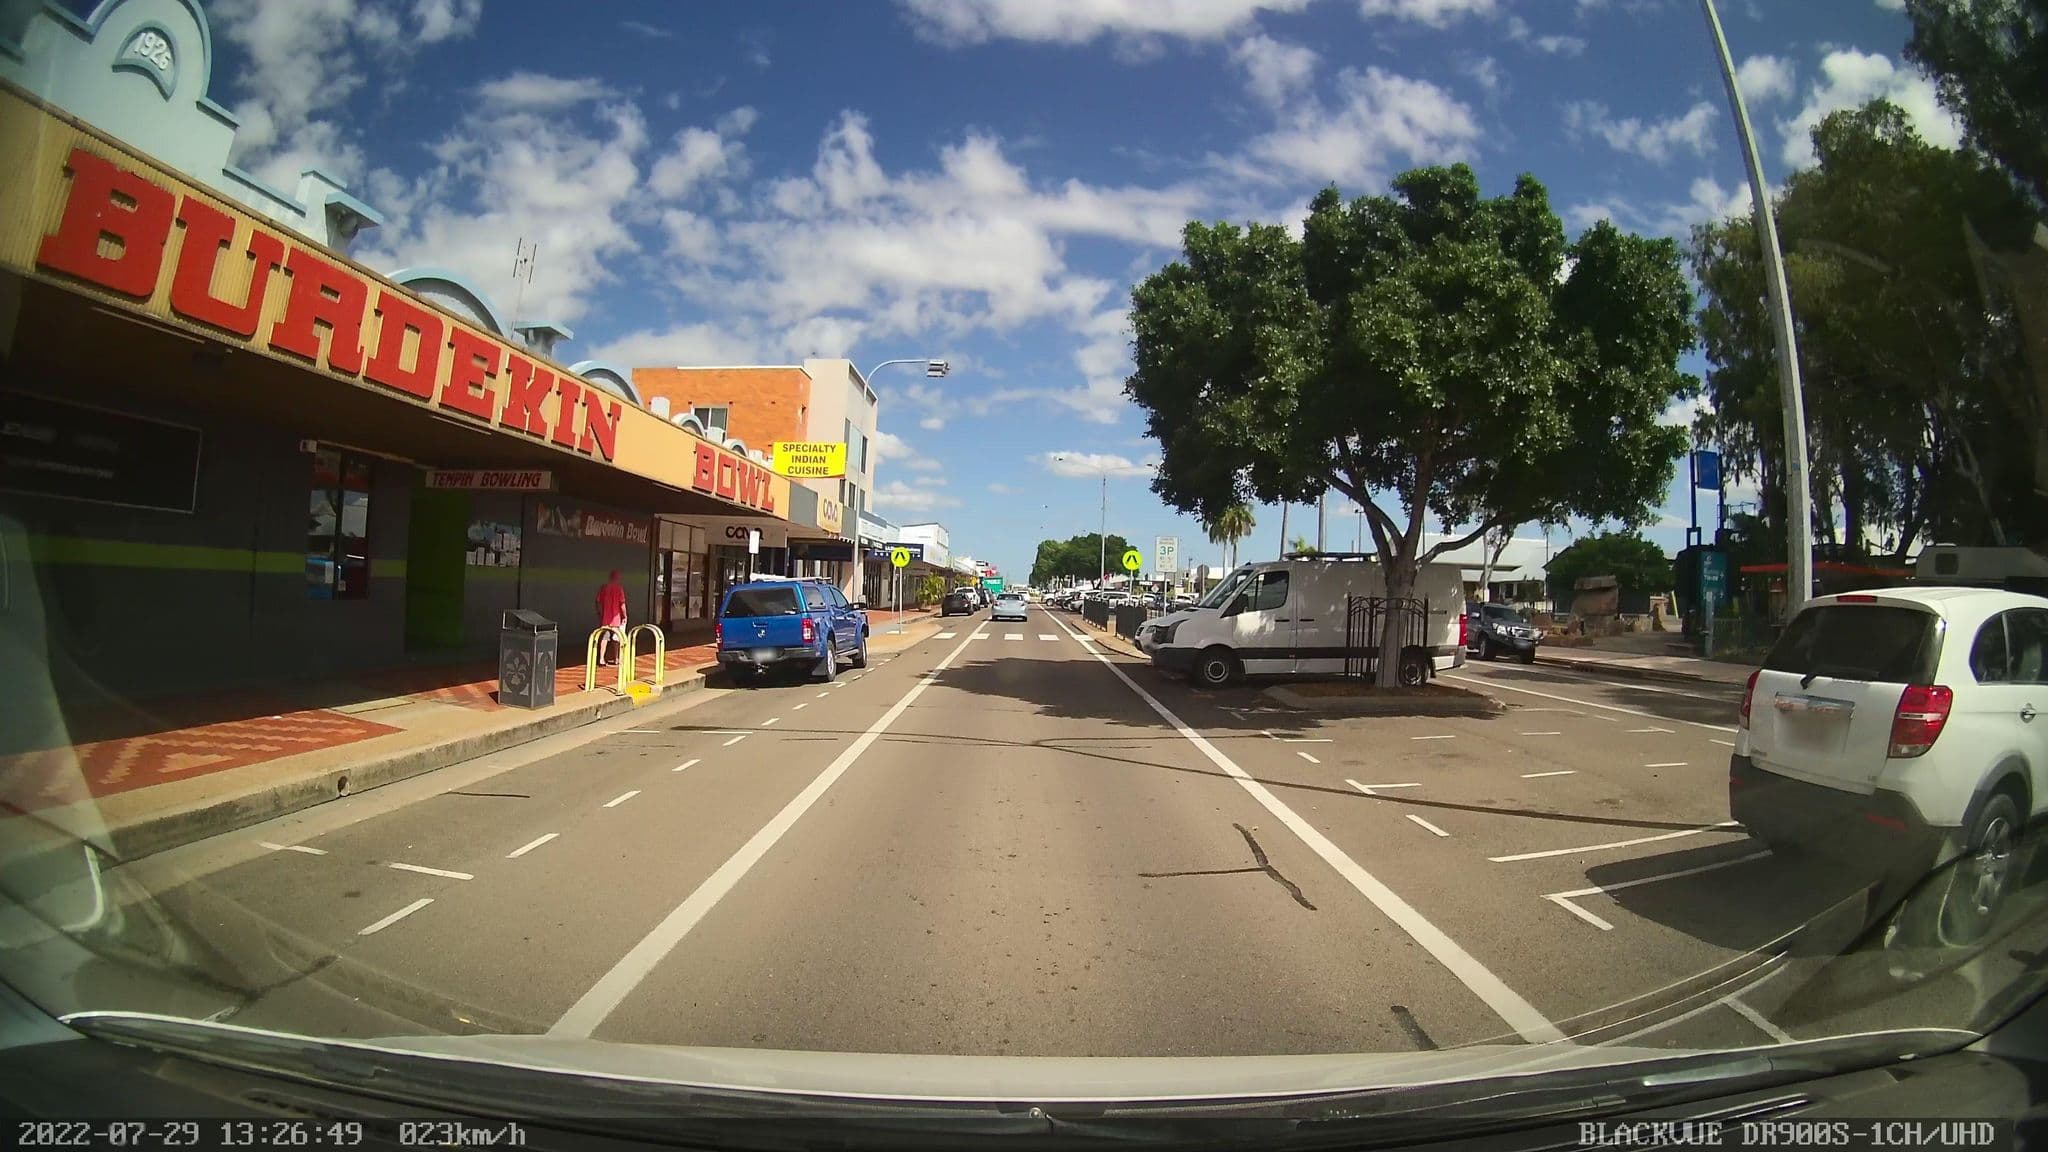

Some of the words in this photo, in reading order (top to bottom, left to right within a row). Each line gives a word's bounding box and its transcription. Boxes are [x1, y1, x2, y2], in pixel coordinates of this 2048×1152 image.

[37, 147, 622, 461] BURDEKIN
[782, 443, 836, 453] SPECIALTY
[791, 454, 826, 464] INDIAN
[788, 465, 829, 475] CUISINE
[433, 472, 474, 486] TENPIN
[480, 472, 542, 487] BOWLING
[691, 443, 774, 512] BOWL
[585, 515, 624, 538] Burdekin
[626, 522, 648, 544] Bowl
[1159, 545, 1175, 556] 3P
